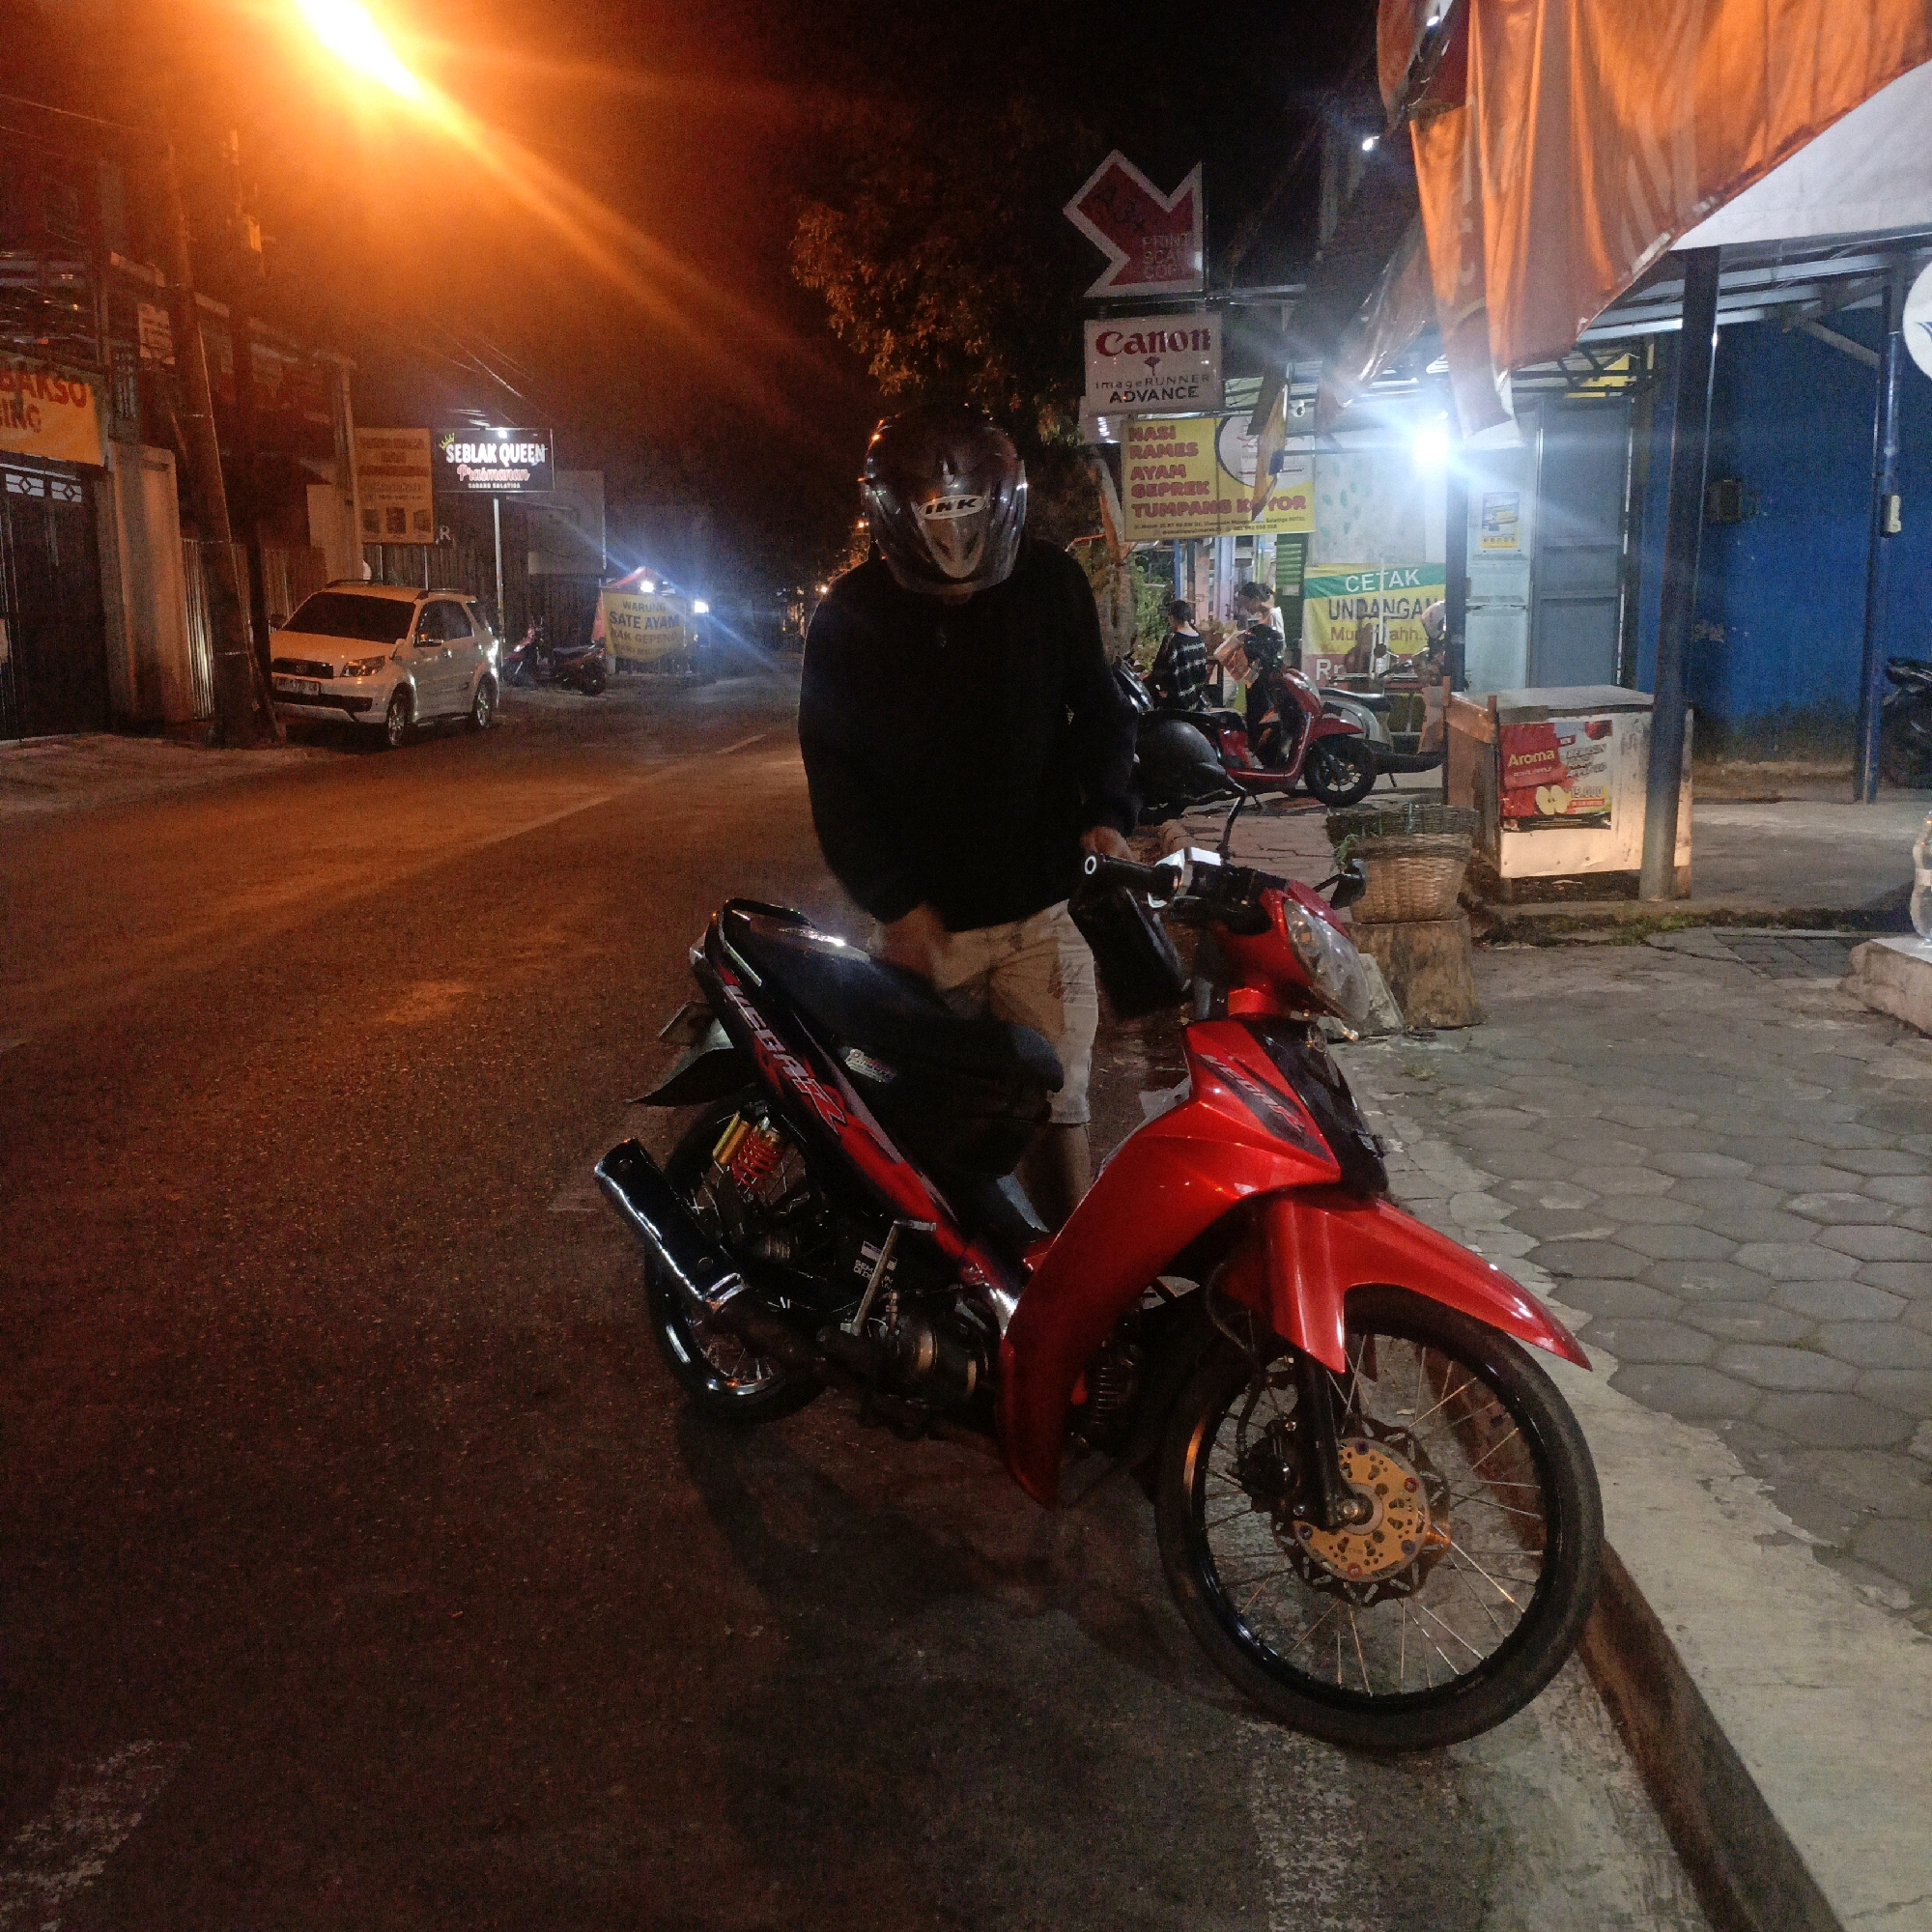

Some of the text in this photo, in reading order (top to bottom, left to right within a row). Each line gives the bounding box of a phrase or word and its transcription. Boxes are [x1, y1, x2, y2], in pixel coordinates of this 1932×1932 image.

[1095, 327, 1211, 357] Canon
[1094, 374, 1210, 390] imageRUNNER
[1109, 385, 1200, 404] ADVANCE
[0, 397, 42, 434] ING
[1128, 425, 1177, 442] NASI
[445, 442, 497, 463] SEBLAK
[498, 442, 547, 468] QUEEN
[1129, 441, 1200, 460] RAMES
[1130, 464, 1187, 481] AYAM
[1130, 480, 1210, 498] GEPREK
[1131, 496, 1307, 519] TUMPANG KYOR
[1345, 568, 1421, 593] CETAK
[609, 611, 680, 631] SATE AYAM
[1507, 749, 1556, 768] Aroma
[723, 983, 810, 1079] VEGA
